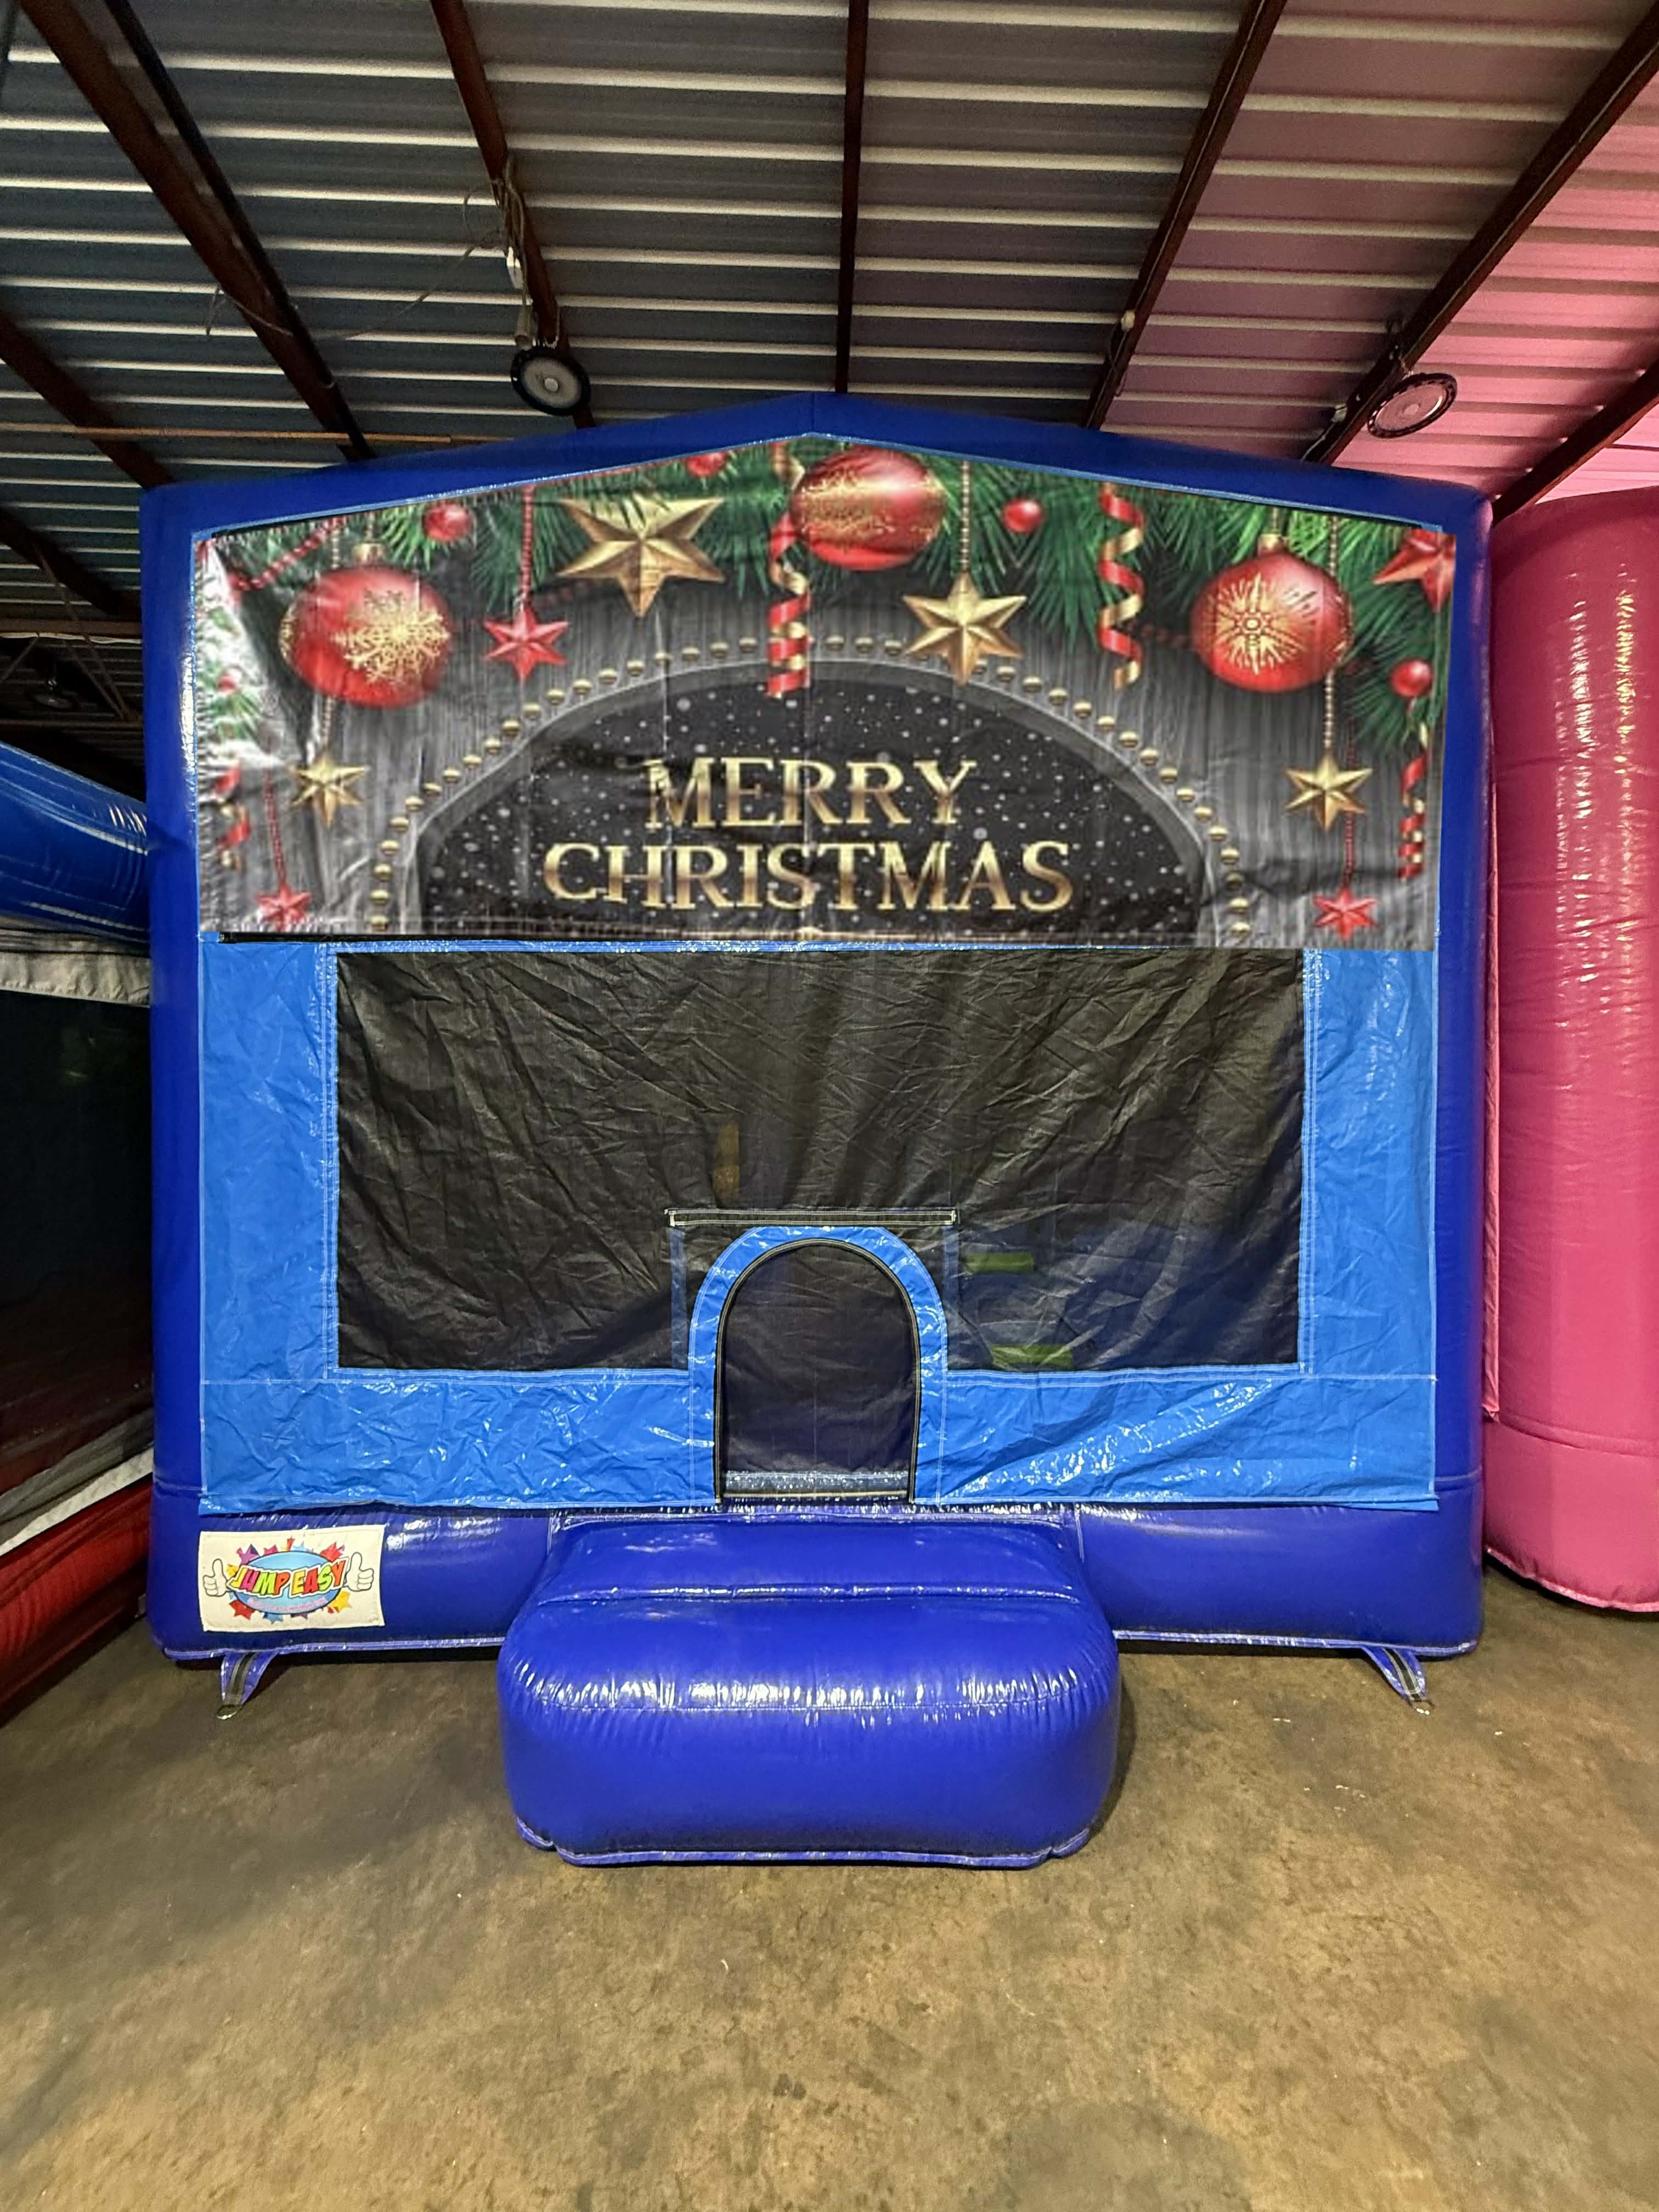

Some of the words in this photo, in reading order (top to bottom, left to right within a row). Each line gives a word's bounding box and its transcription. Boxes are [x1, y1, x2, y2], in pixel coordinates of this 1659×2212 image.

[644, 758, 977, 829] MERRY
[544, 841, 1073, 911] CHRISTMAS
[230, 1565, 290, 1595] JUMP
[291, 1560, 346, 1595] EASY
